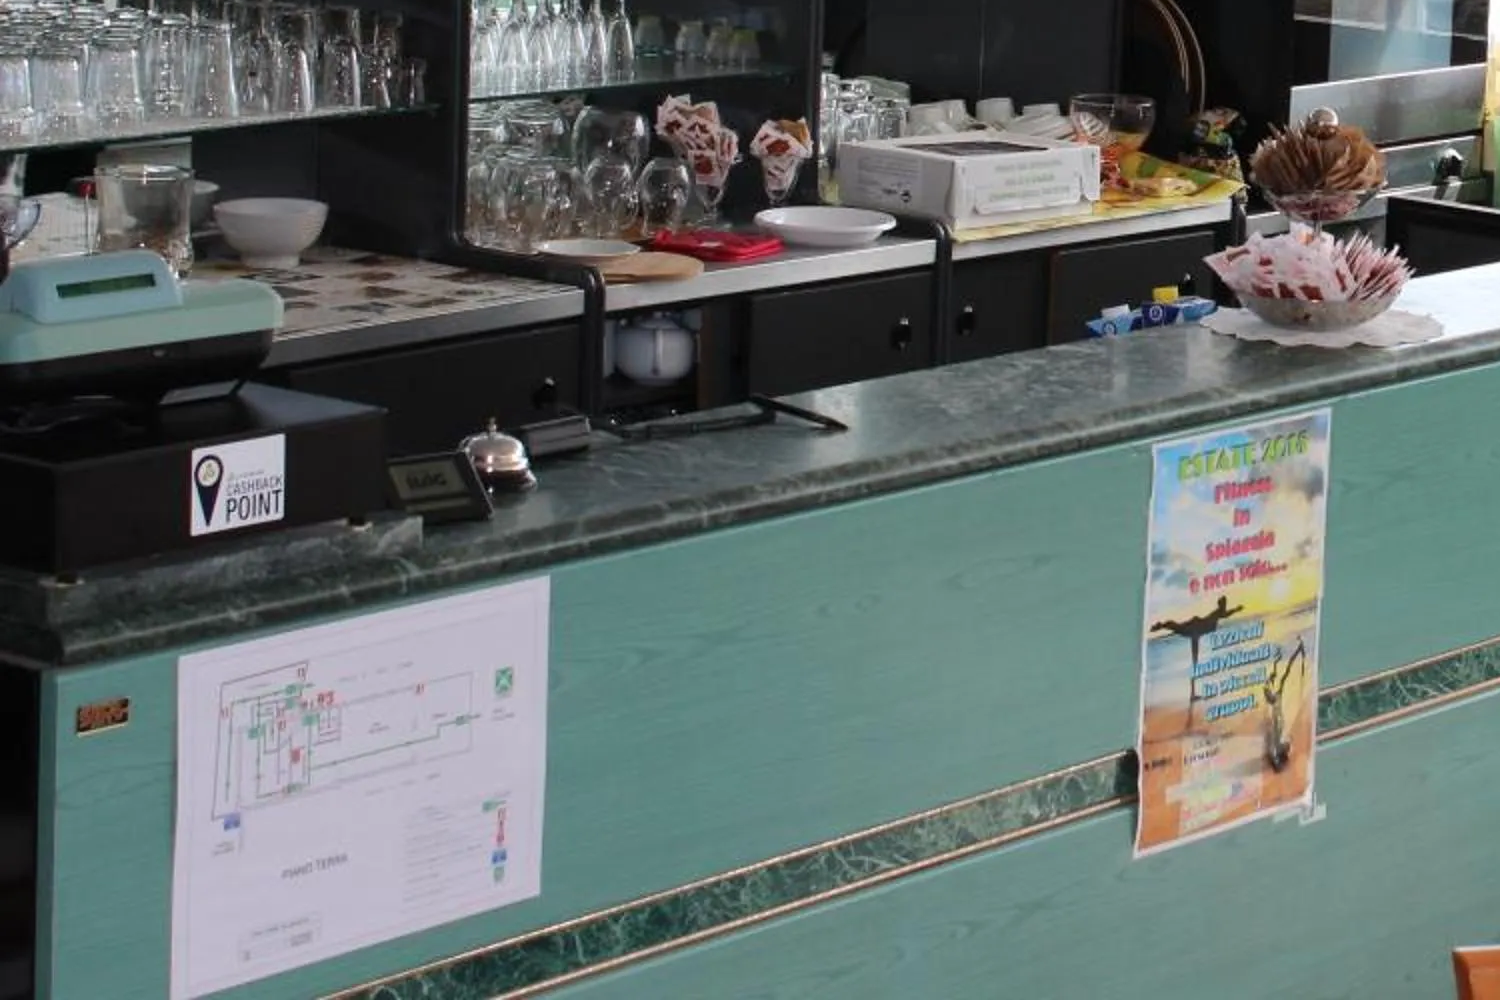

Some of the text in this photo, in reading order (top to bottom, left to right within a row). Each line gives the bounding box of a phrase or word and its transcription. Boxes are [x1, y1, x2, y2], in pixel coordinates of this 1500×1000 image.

[1178, 441, 1257, 483] ESTATE
[226, 475, 283, 496] CASHBACK
[225, 489, 282, 524] POINT
